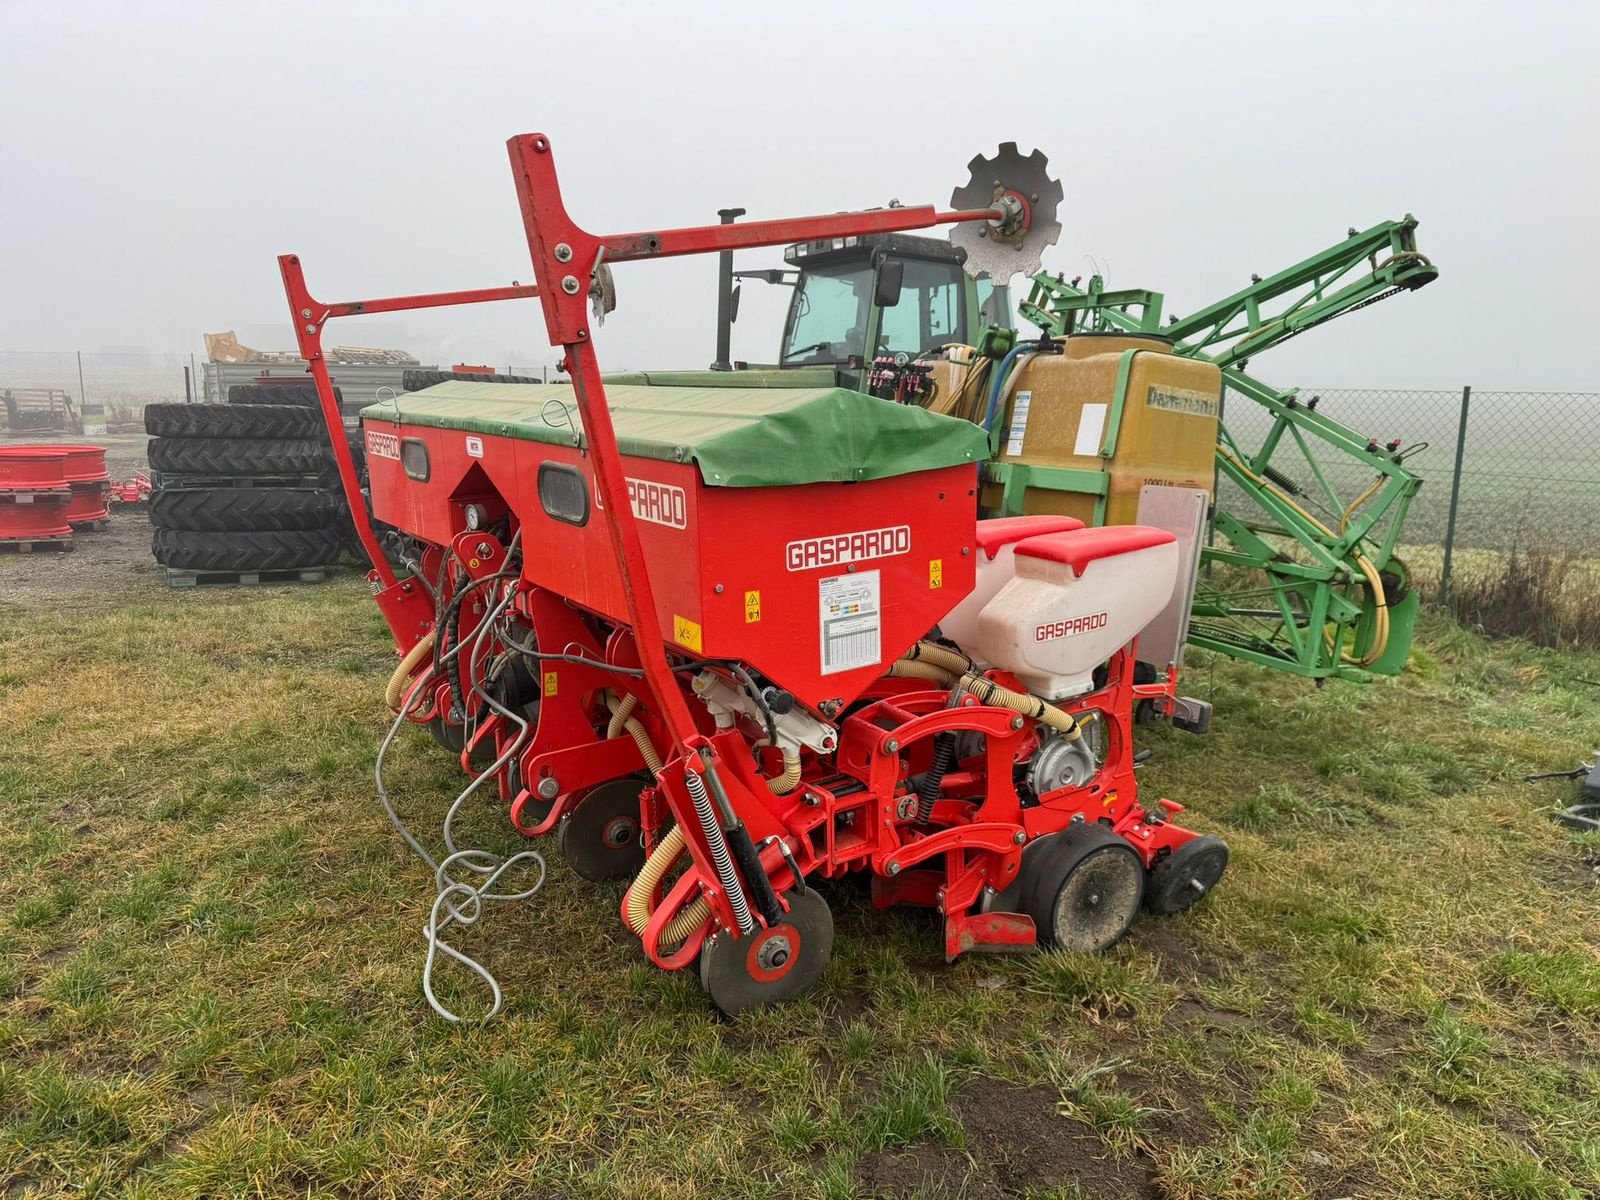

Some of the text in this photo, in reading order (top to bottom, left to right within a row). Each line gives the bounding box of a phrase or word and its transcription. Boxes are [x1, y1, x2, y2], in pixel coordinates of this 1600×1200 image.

[367, 432, 400, 459] GASPARDO
[788, 527, 909, 570] GASPARDO
[1036, 612, 1107, 641] GASPARDO
